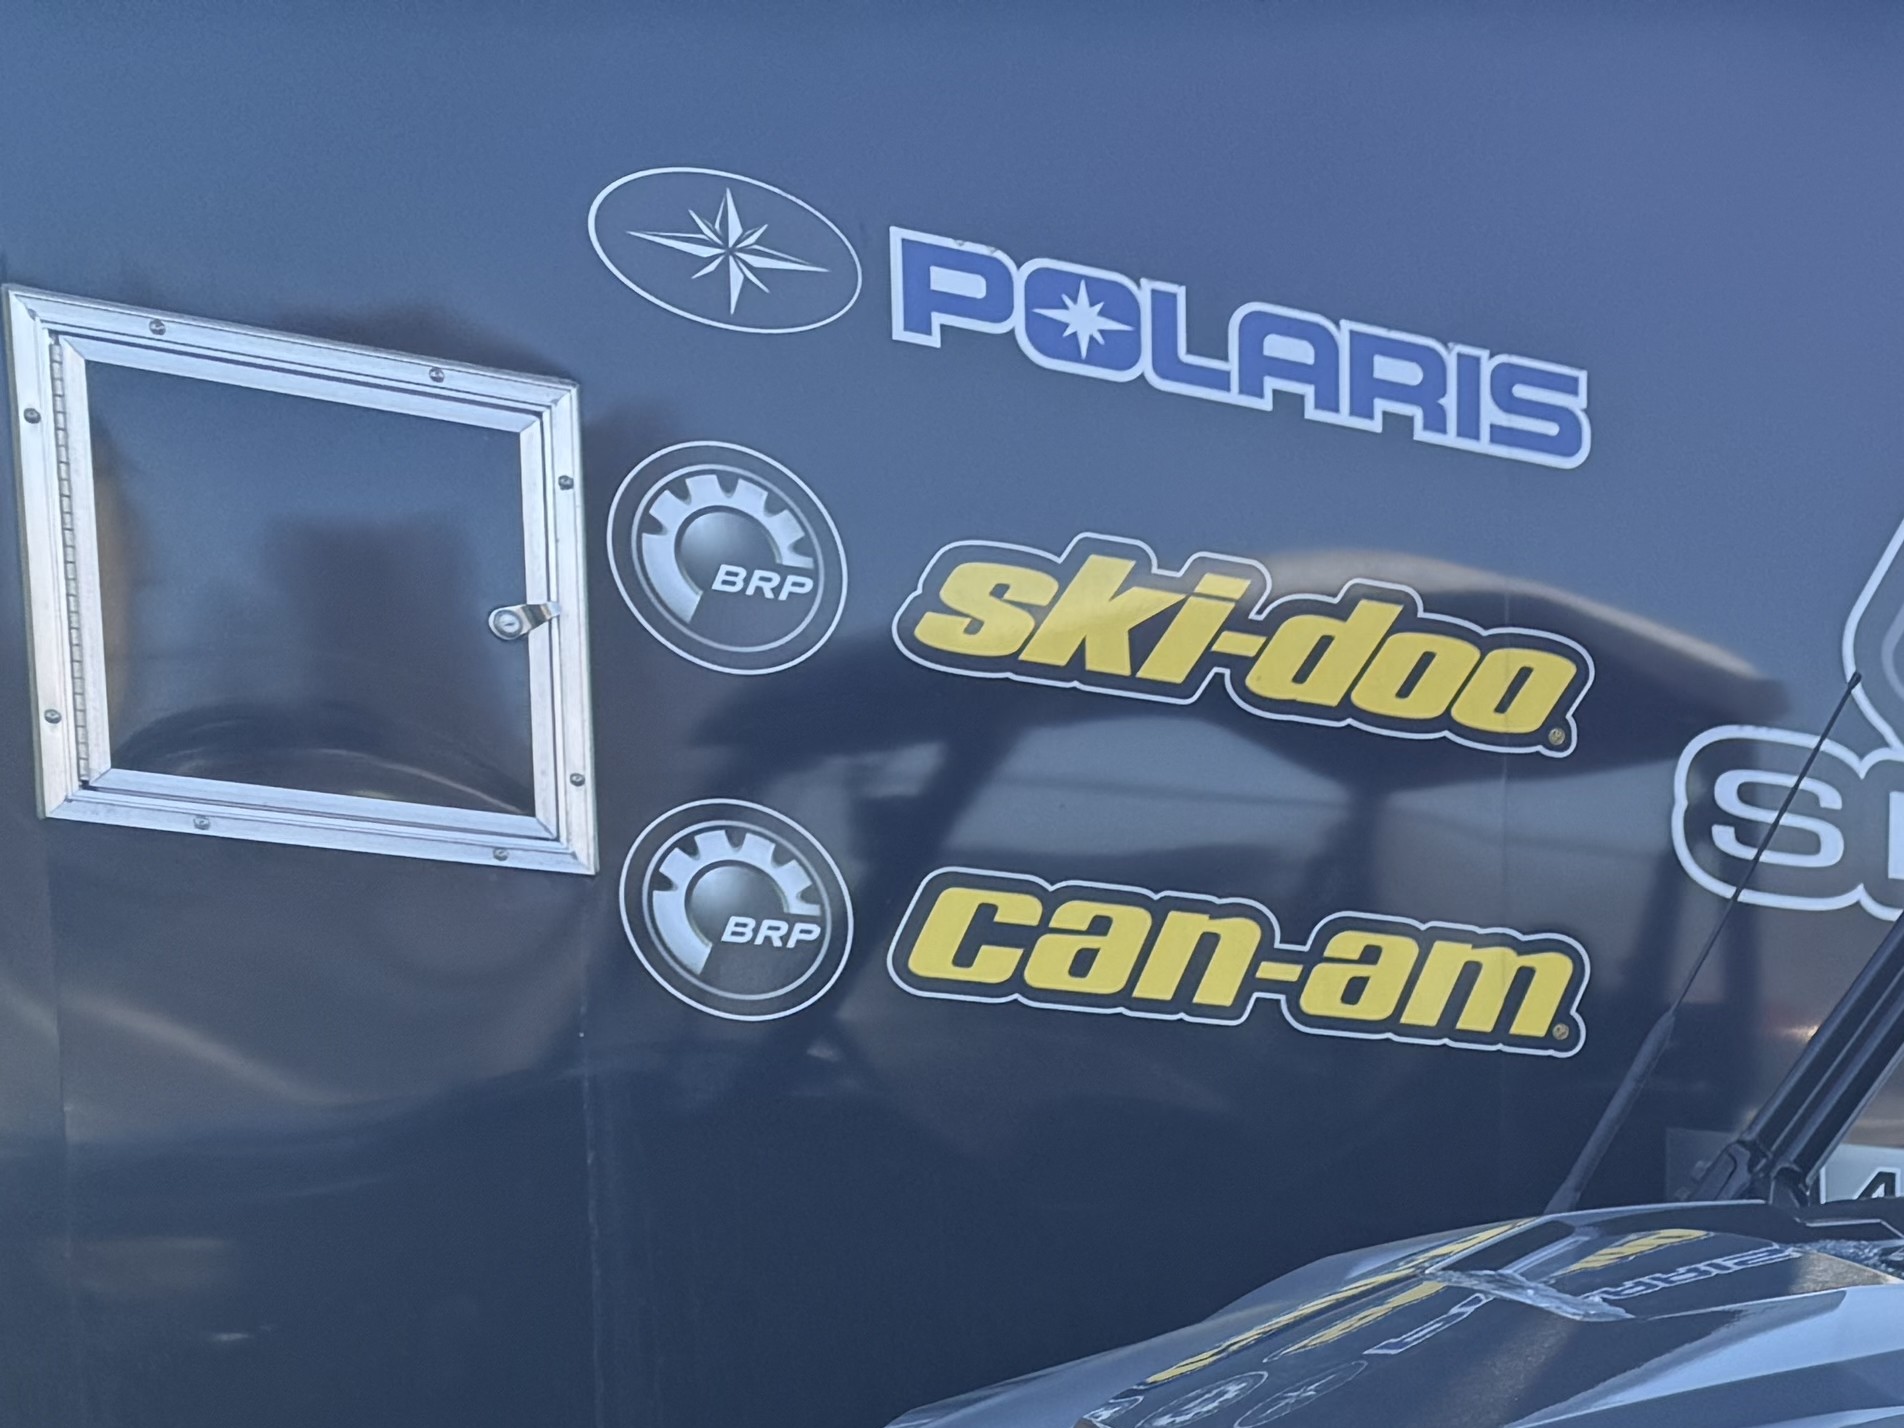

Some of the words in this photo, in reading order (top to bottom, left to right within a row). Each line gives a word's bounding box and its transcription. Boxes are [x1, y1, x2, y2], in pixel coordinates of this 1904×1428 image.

[892, 229, 1589, 466] POLARIS
[712, 564, 814, 600] BRP
[914, 554, 1577, 733] ski-doo
[721, 916, 821, 948] BRP
[907, 882, 1578, 1037] can-am
